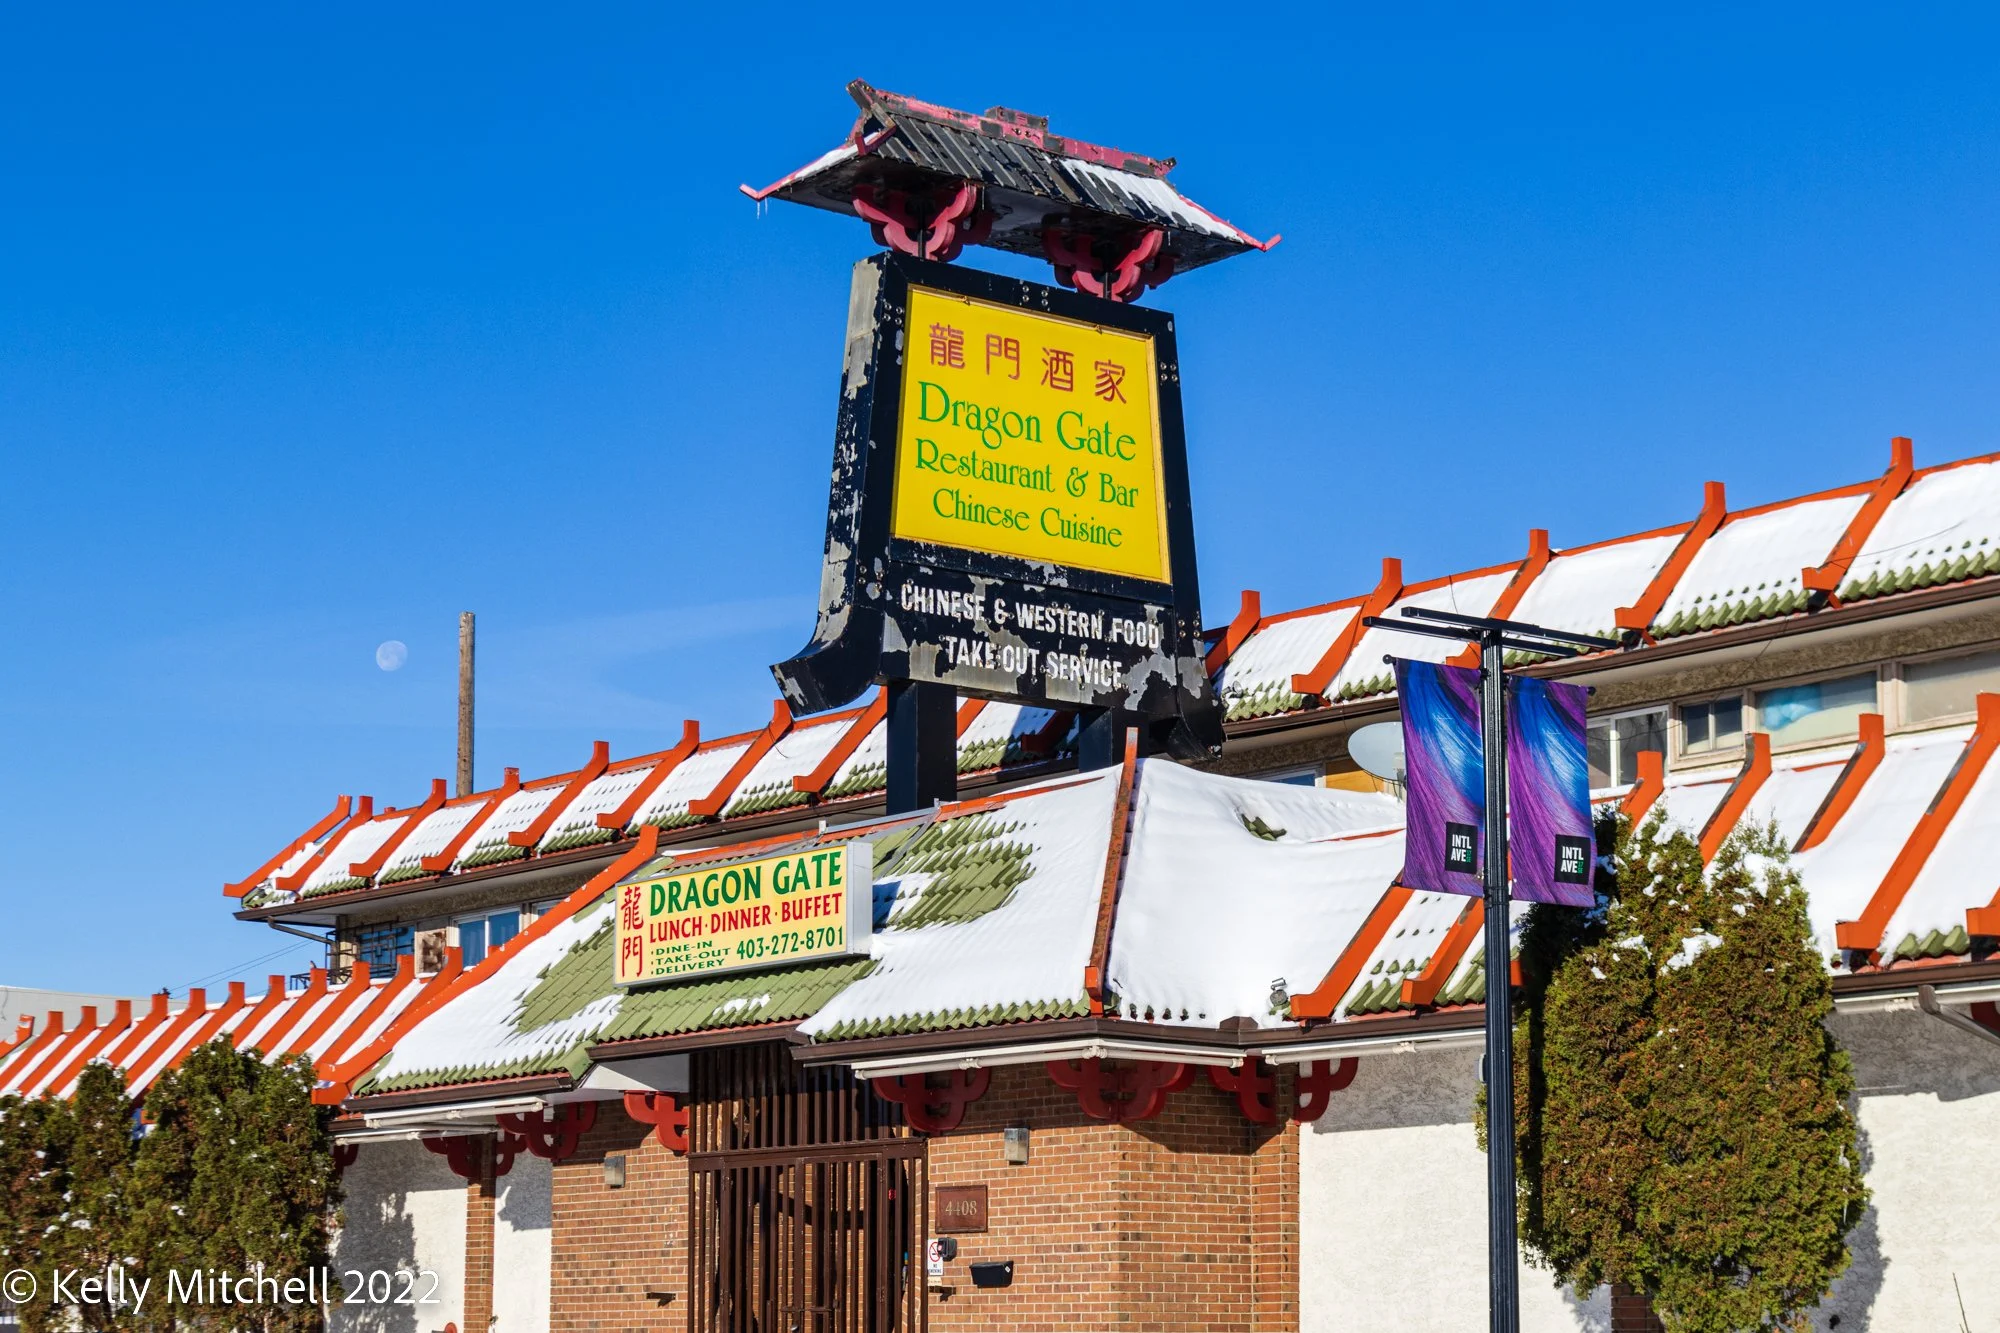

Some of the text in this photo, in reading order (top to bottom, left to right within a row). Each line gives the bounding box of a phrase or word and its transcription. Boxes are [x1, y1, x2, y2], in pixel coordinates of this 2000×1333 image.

[929, 322, 1127, 404] 龍門酒家
[918, 381, 1136, 460] Dragon Gate
[915, 439, 1138, 507] Restaurant & Bar
[933, 488, 1122, 548] Chinese Cuisine
[901, 583, 1159, 649] CHINESE & WESTERN FOOD
[1046, 651, 1122, 689] SERVICE
[1450, 847, 1466, 862] AVE
[1452, 834, 1472, 849] INTL
[1562, 845, 1584, 860] INTL
[650, 851, 842, 916] DRAGON GATE
[1560, 859, 1578, 873] AVE
[621, 886, 644, 978] 龍門
[650, 892, 842, 943] LUNCH DINNER BUFFET
[655, 940, 713, 956] DINE-IN
[655, 948, 731, 966] TAKE-OUT
[736, 926, 843, 960] 403-272-8701
[655, 958, 725, 975] DELIVERY
[945, 1200, 977, 1216] 4408
